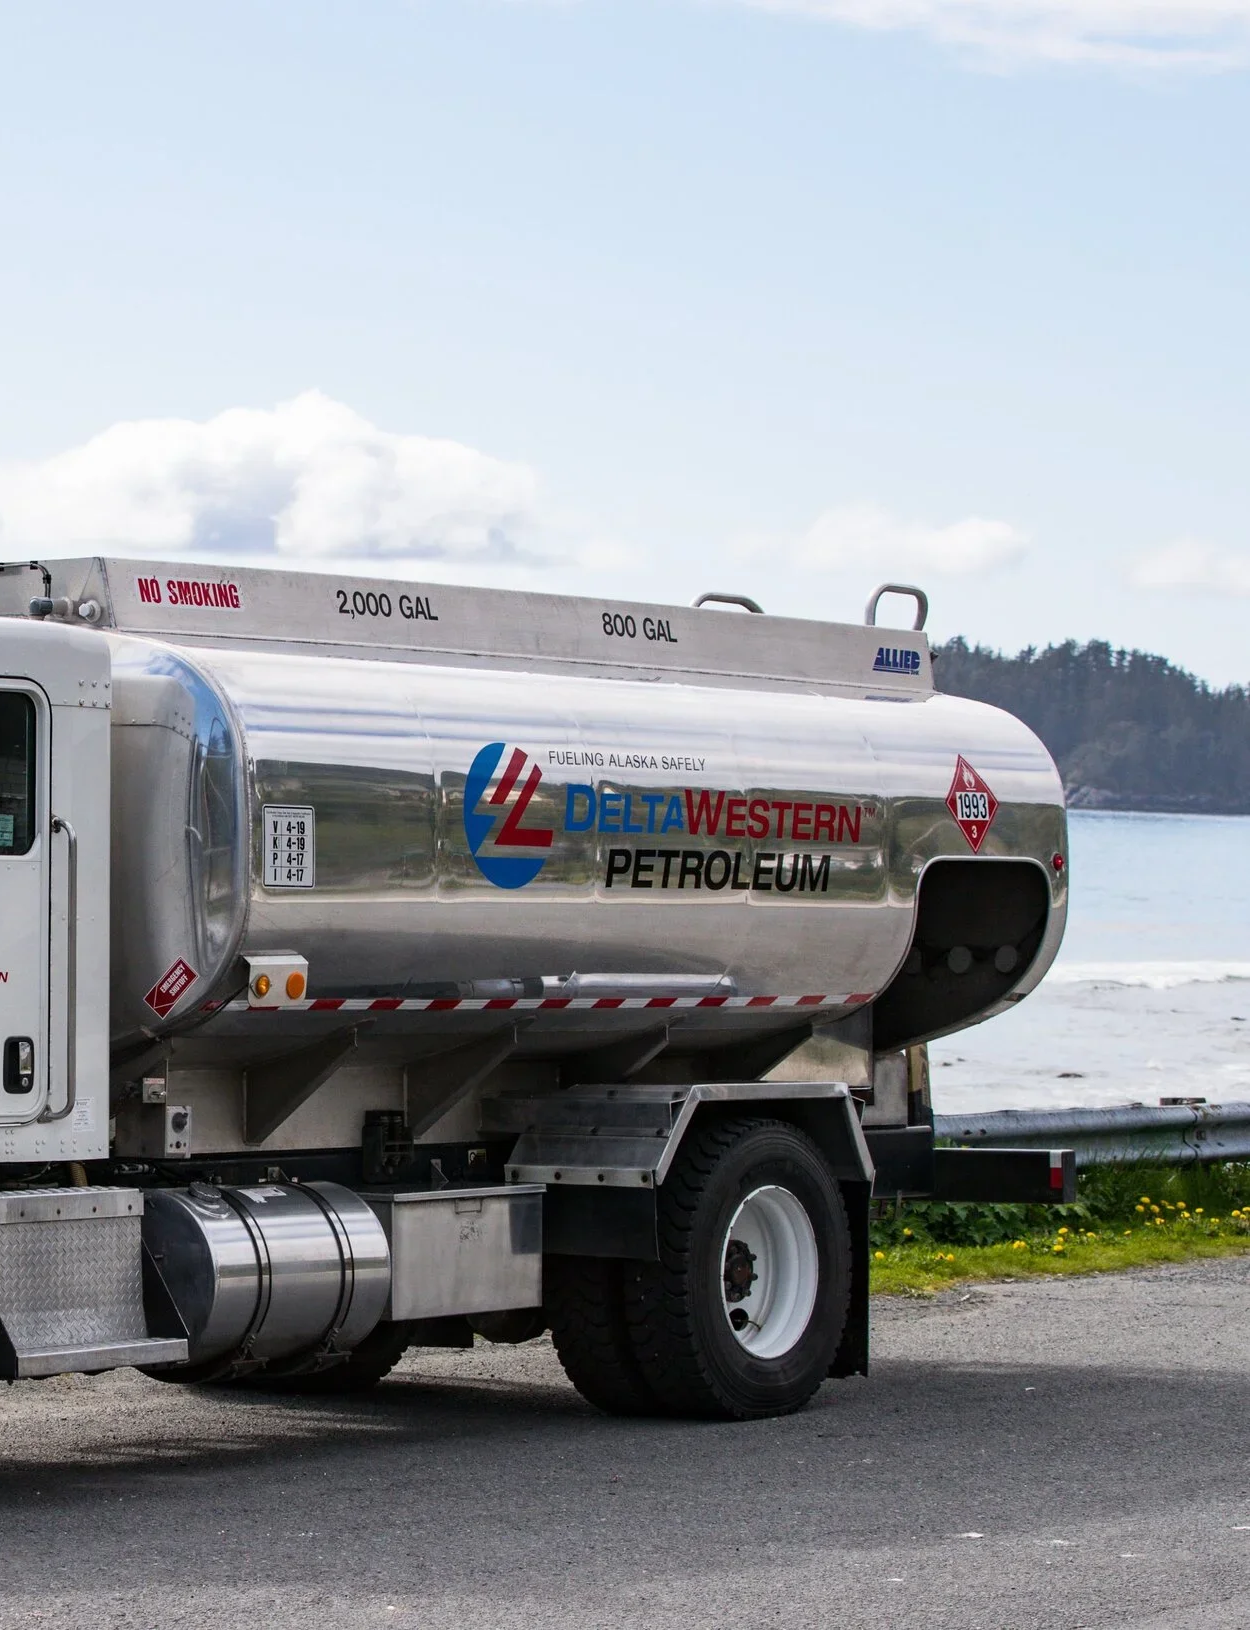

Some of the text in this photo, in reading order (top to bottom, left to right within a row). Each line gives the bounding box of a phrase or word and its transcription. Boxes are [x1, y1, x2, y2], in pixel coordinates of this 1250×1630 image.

[137, 577, 241, 609] NO SMOKING
[336, 590, 439, 621] 2,000 GAL
[601, 612, 678, 643] 800 GAL
[873, 647, 920, 669] ALLIED
[548, 751, 706, 771] FUELING ALASKA SAFELY
[958, 794, 987, 819] 1993
[273, 821, 305, 834] V 4-19
[971, 825, 978, 838] 3
[273, 836, 305, 850] K 4-19
[273, 853, 304, 865] P 4-17
[605, 848, 831, 892] PETROLEUM
[286, 869, 304, 881] 4-17
[160, 963, 185, 994] EMERGENCY
[169, 973, 188, 997] SHUTOFF
